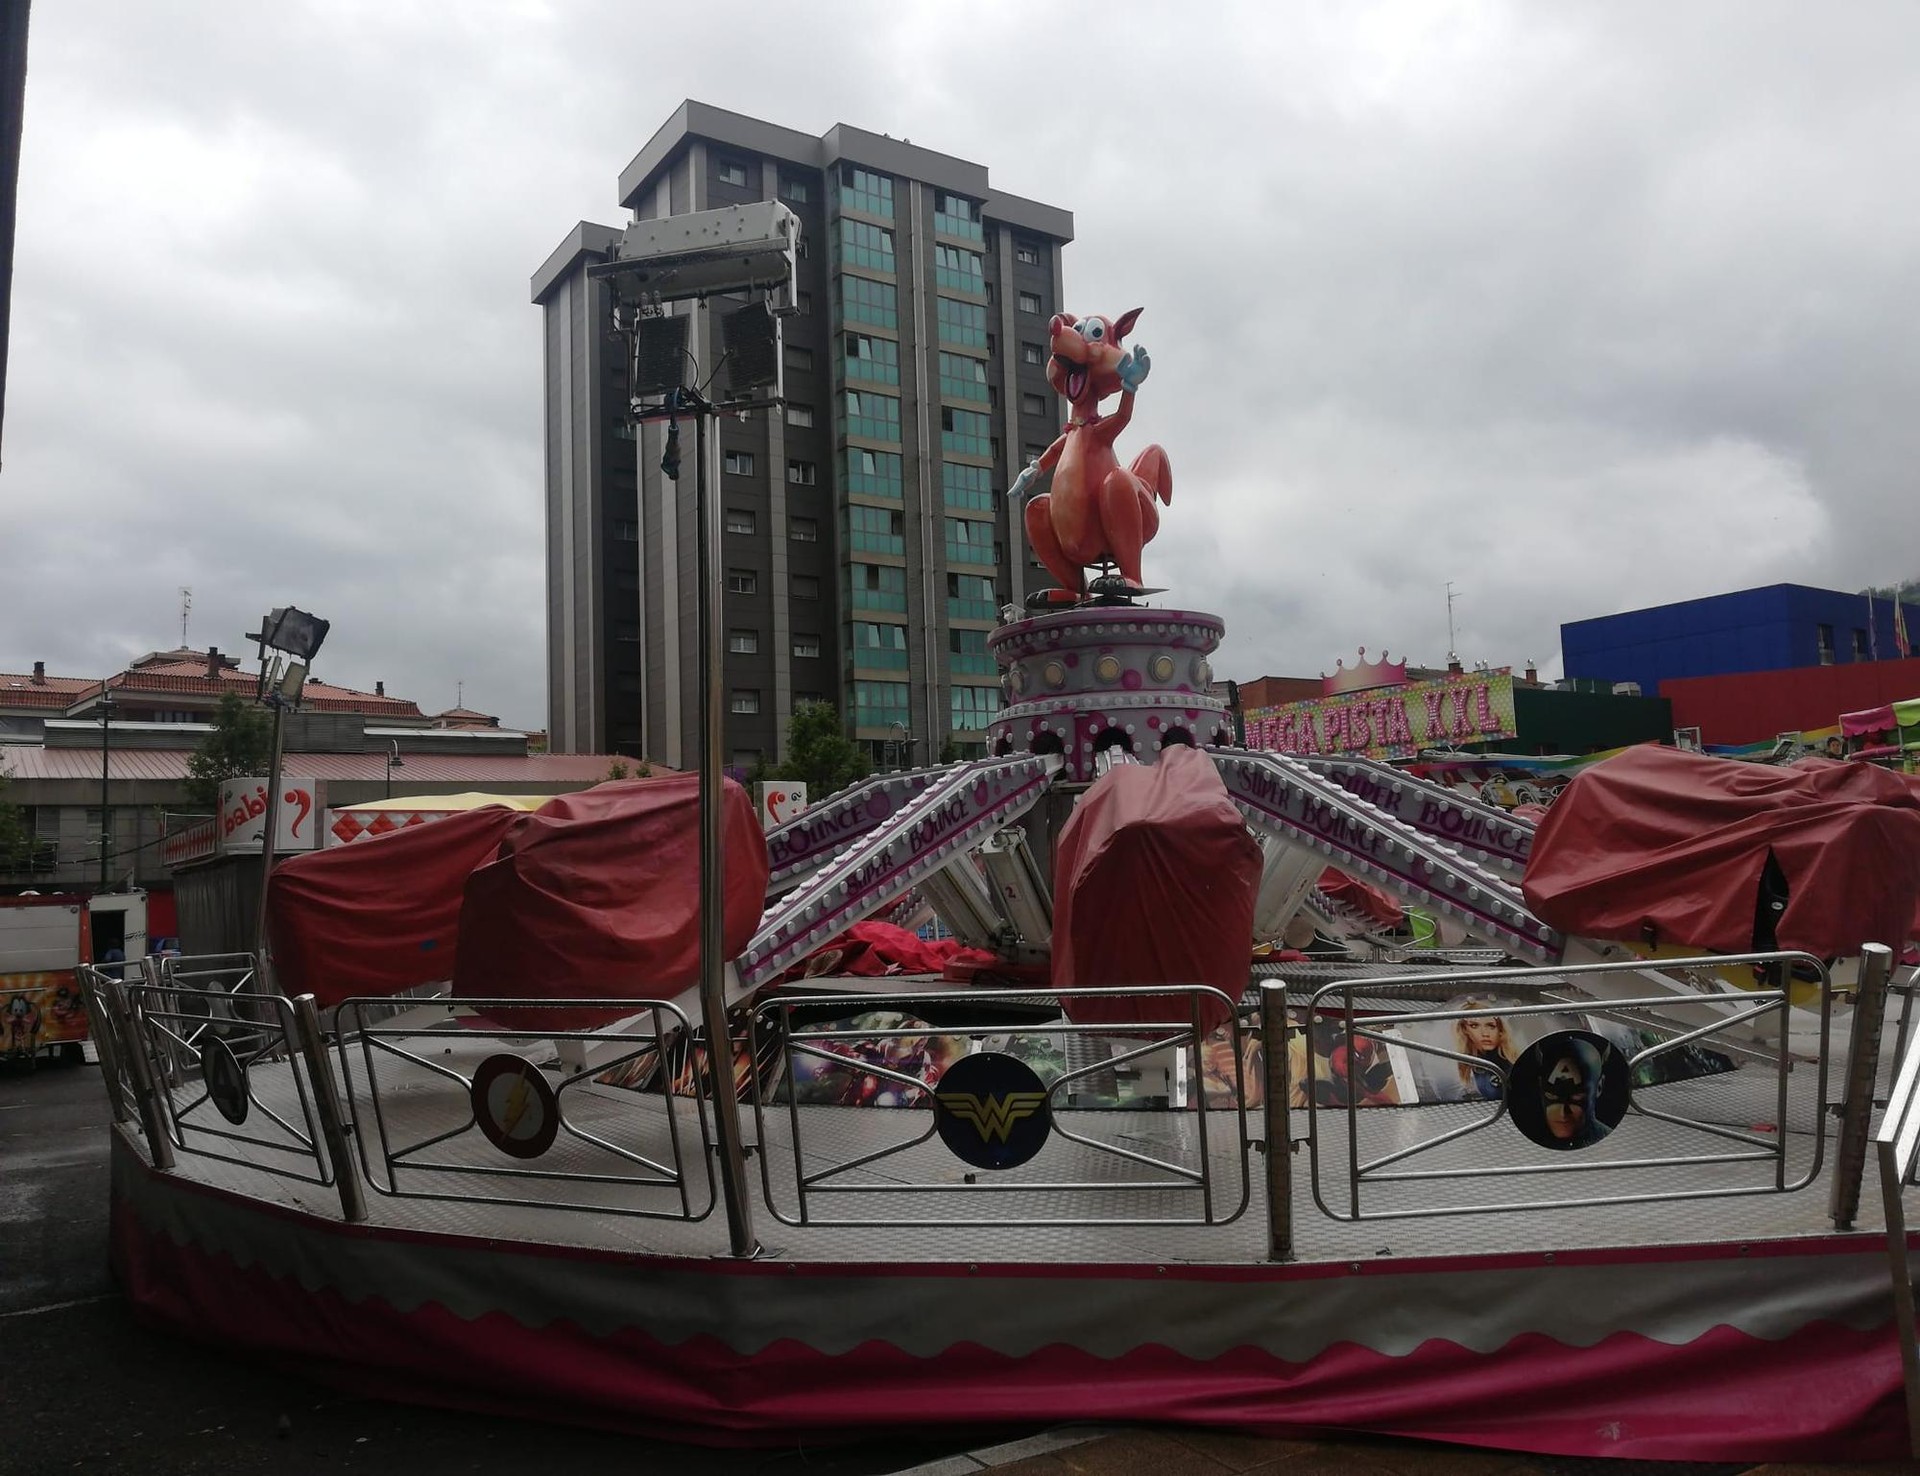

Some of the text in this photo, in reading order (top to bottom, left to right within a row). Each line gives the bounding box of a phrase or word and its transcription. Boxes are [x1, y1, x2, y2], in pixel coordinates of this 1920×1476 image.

[1323, 696, 1413, 750] PISTA
[1421, 683, 1500, 739] XXL
[771, 804, 866, 864] BOUNCE
[1240, 766, 1381, 853] SUPER BOUNCE
[1331, 770, 1532, 853] SUPER BOUNCE
[847, 799, 971, 899] SUPER BOUNCE
[1005, 886, 1017, 899] 2
